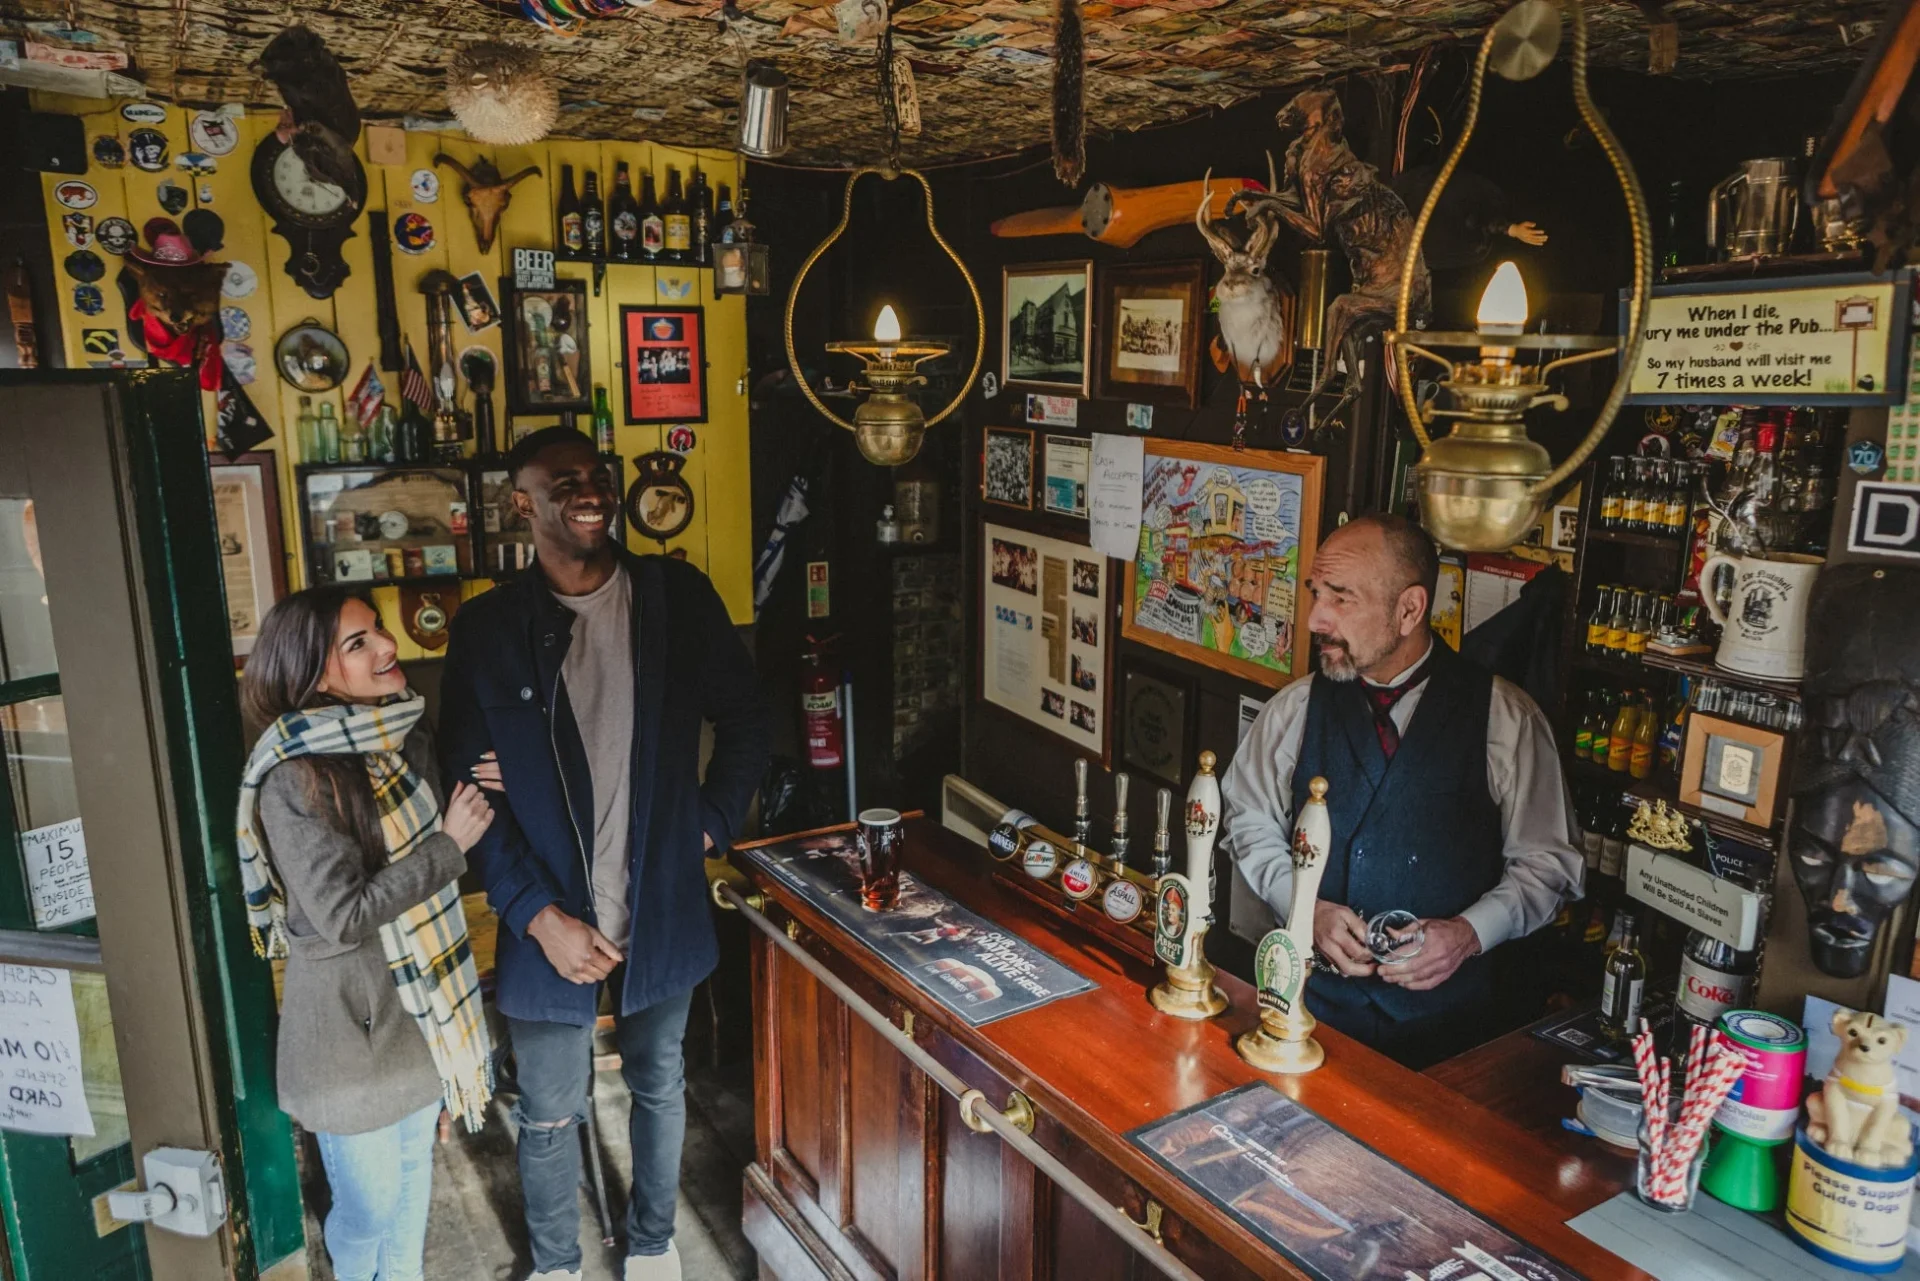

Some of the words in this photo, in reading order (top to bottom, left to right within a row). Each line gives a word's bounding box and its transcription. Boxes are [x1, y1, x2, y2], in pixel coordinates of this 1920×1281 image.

[515, 249, 554, 272] BEER
[1688, 306, 1735, 322] When
[1741, 305, 1747, 320] I
[1753, 304, 1780, 320] die,
[1644, 326, 1671, 342] ury
[1677, 326, 1699, 339] me
[1704, 323, 1751, 338] under
[1755, 322, 1783, 336] the
[1647, 357, 1661, 369] So
[1665, 358, 1685, 371] my
[1689, 356, 1741, 368] husband
[1746, 354, 1770, 367] will
[1775, 354, 1805, 366] visit
[1810, 355, 1832, 365] me
[1657, 372, 1669, 389] 7
[1675, 372, 1726, 389] times
[1733, 374, 1744, 387] a
[1751, 369, 1813, 388] week!
[1854, 450, 1876, 465] 70
[1483, 565, 1512, 577] FEBRUARY
[28, 823, 81, 847] MAXIMU
[45, 838, 74, 864] 15
[1715, 853, 1743, 867] POLICE
[40, 856, 88, 880] PEOPLE
[1069, 869, 1089, 882] AMSTEL
[42, 884, 86, 907] INSIDE
[1109, 886, 1137, 905] ASPALL
[1639, 869, 1653, 883] Any
[1654, 875, 1695, 901] Unattended
[1696, 895, 1729, 917] Children
[46, 904, 71, 922] ONE
[1642, 882, 1656, 895] Will
[1656, 889, 1667, 900] Be
[1667, 894, 1684, 909] Sold
[1685, 903, 1695, 914] As
[1697, 908, 1722, 927] Slaves
[988, 932, 1016, 949] OUR
[1157, 934, 1183, 955] ABBOT
[1162, 946, 1177, 960] ALE
[975, 952, 1018, 979] ALIVE
[1013, 975, 1051, 998] HERE
[1688, 976, 1734, 1005] Coke
[1803, 1161, 1851, 1192] Please
[1812, 1182, 1857, 1208] Guide
[1863, 1201, 1900, 1214] Dogs
